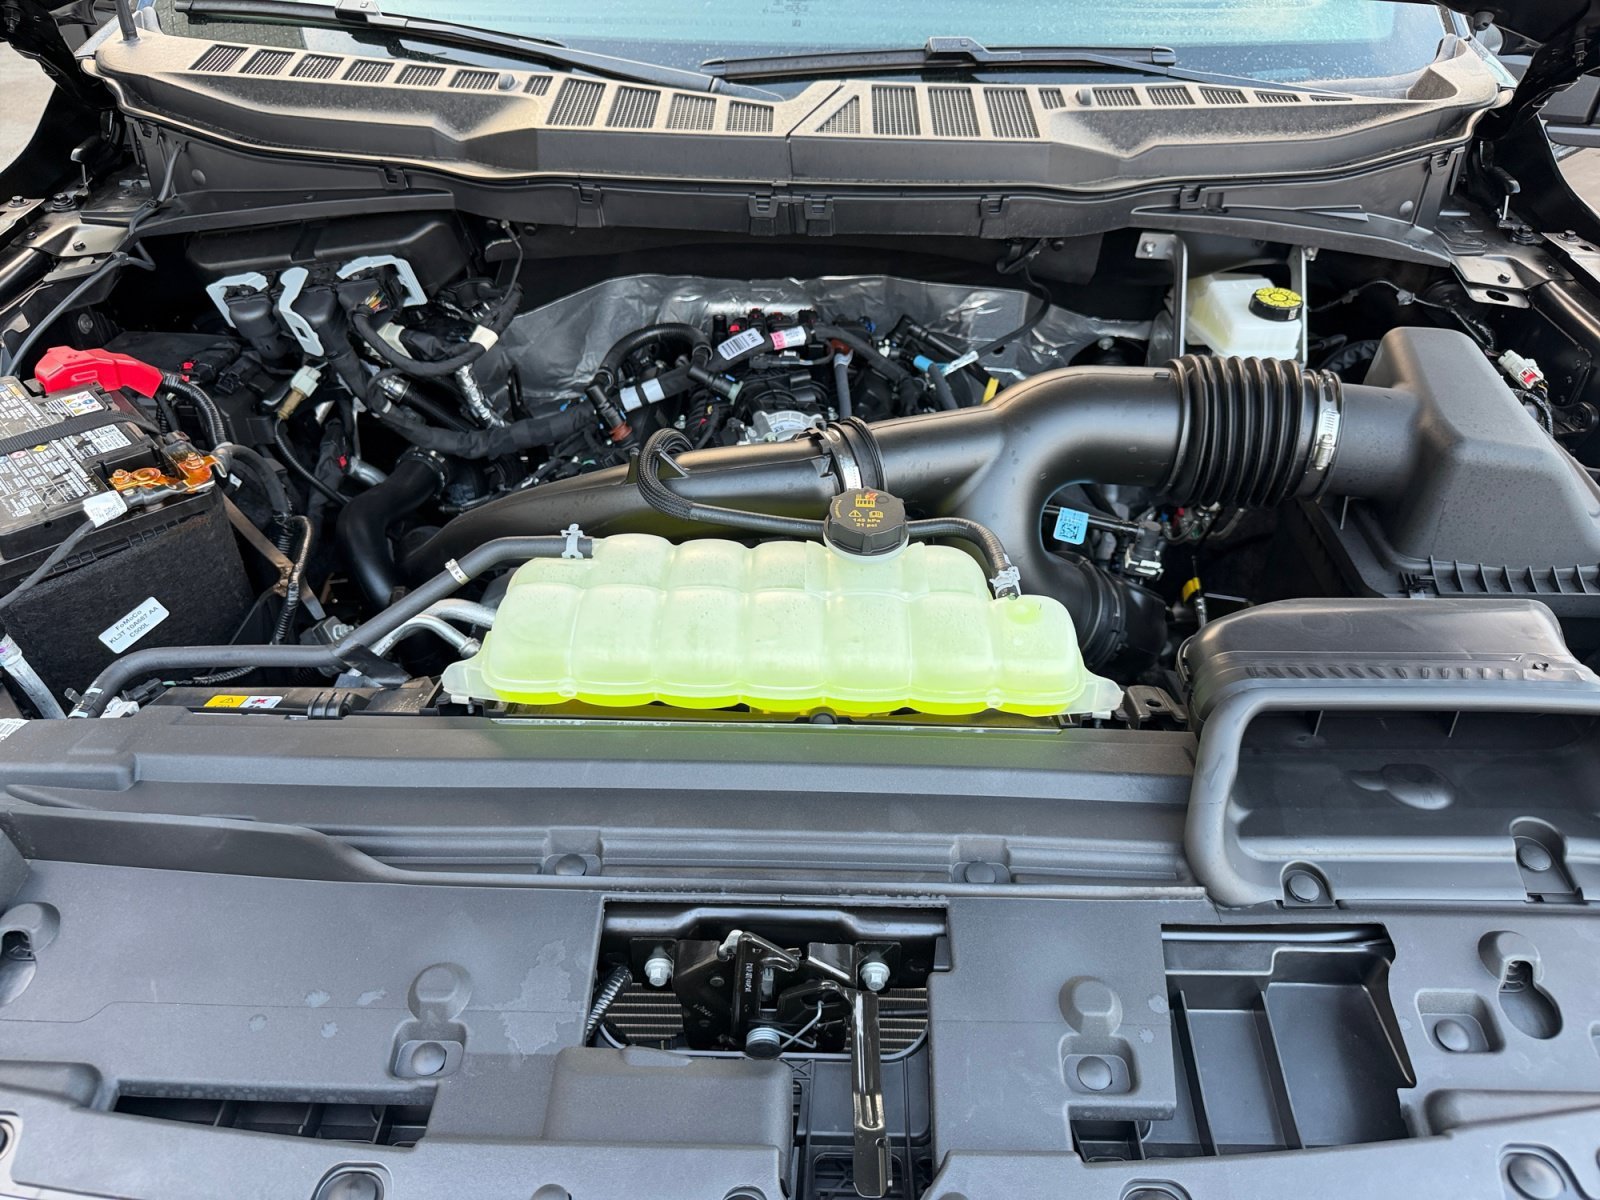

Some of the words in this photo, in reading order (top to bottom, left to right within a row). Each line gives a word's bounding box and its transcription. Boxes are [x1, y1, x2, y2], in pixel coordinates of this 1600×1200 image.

[108, 631, 126, 644] KL3T
[148, 606, 159, 615] AA
[115, 610, 142, 631] FoMoCo
[129, 623, 150, 638] C500L
